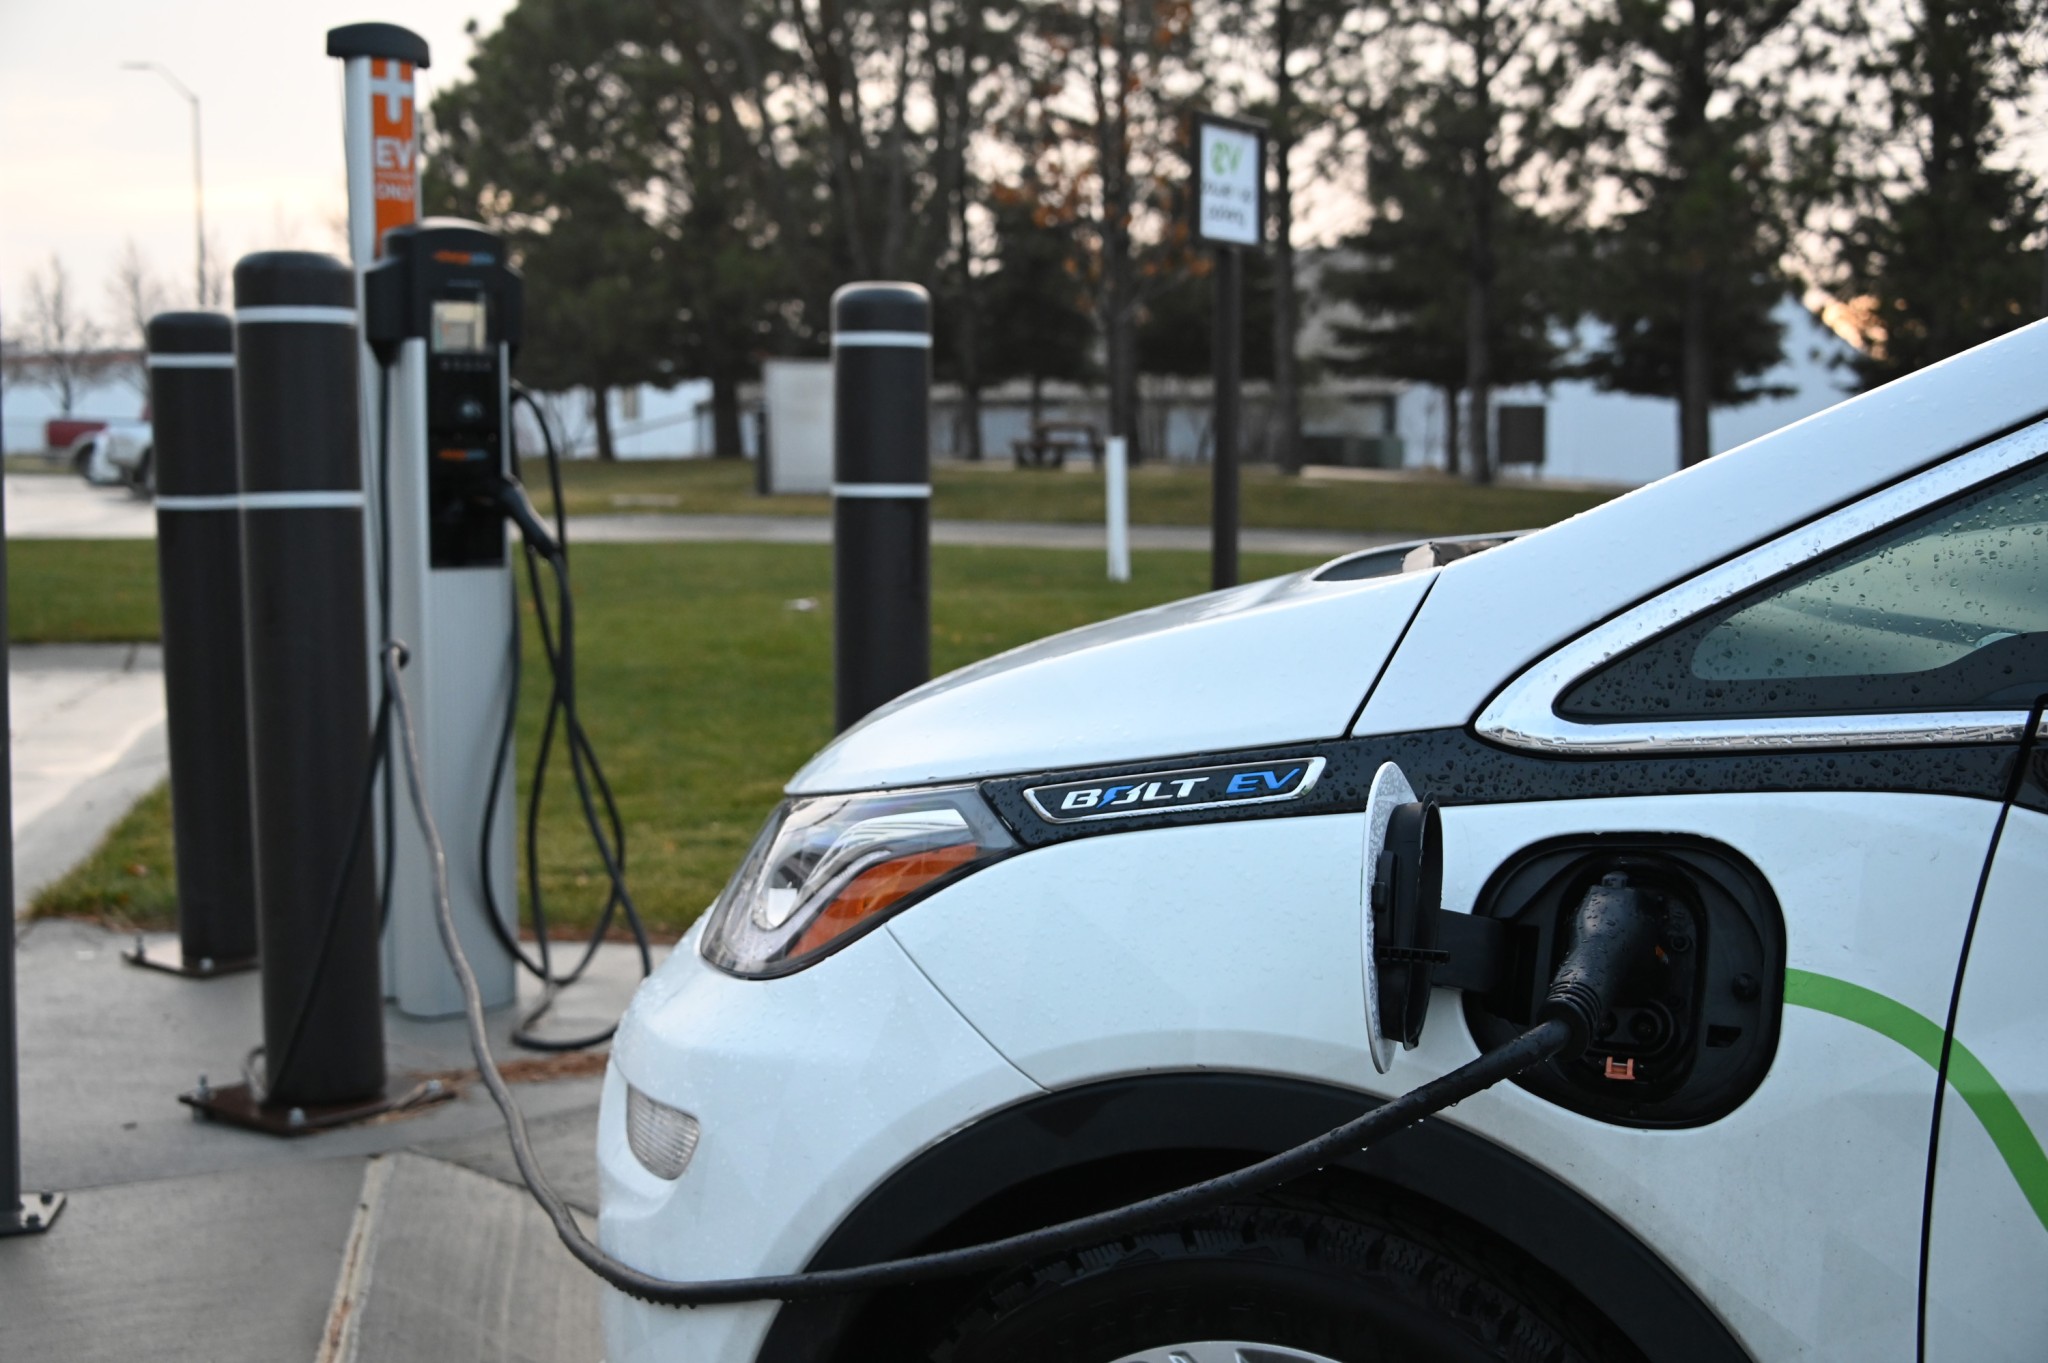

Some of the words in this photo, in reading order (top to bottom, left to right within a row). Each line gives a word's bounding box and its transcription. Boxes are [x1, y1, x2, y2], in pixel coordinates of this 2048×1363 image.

[376, 136, 415, 169] EV
[1060, 776, 1210, 810] BOLT
[1226, 767, 1300, 794] EV
